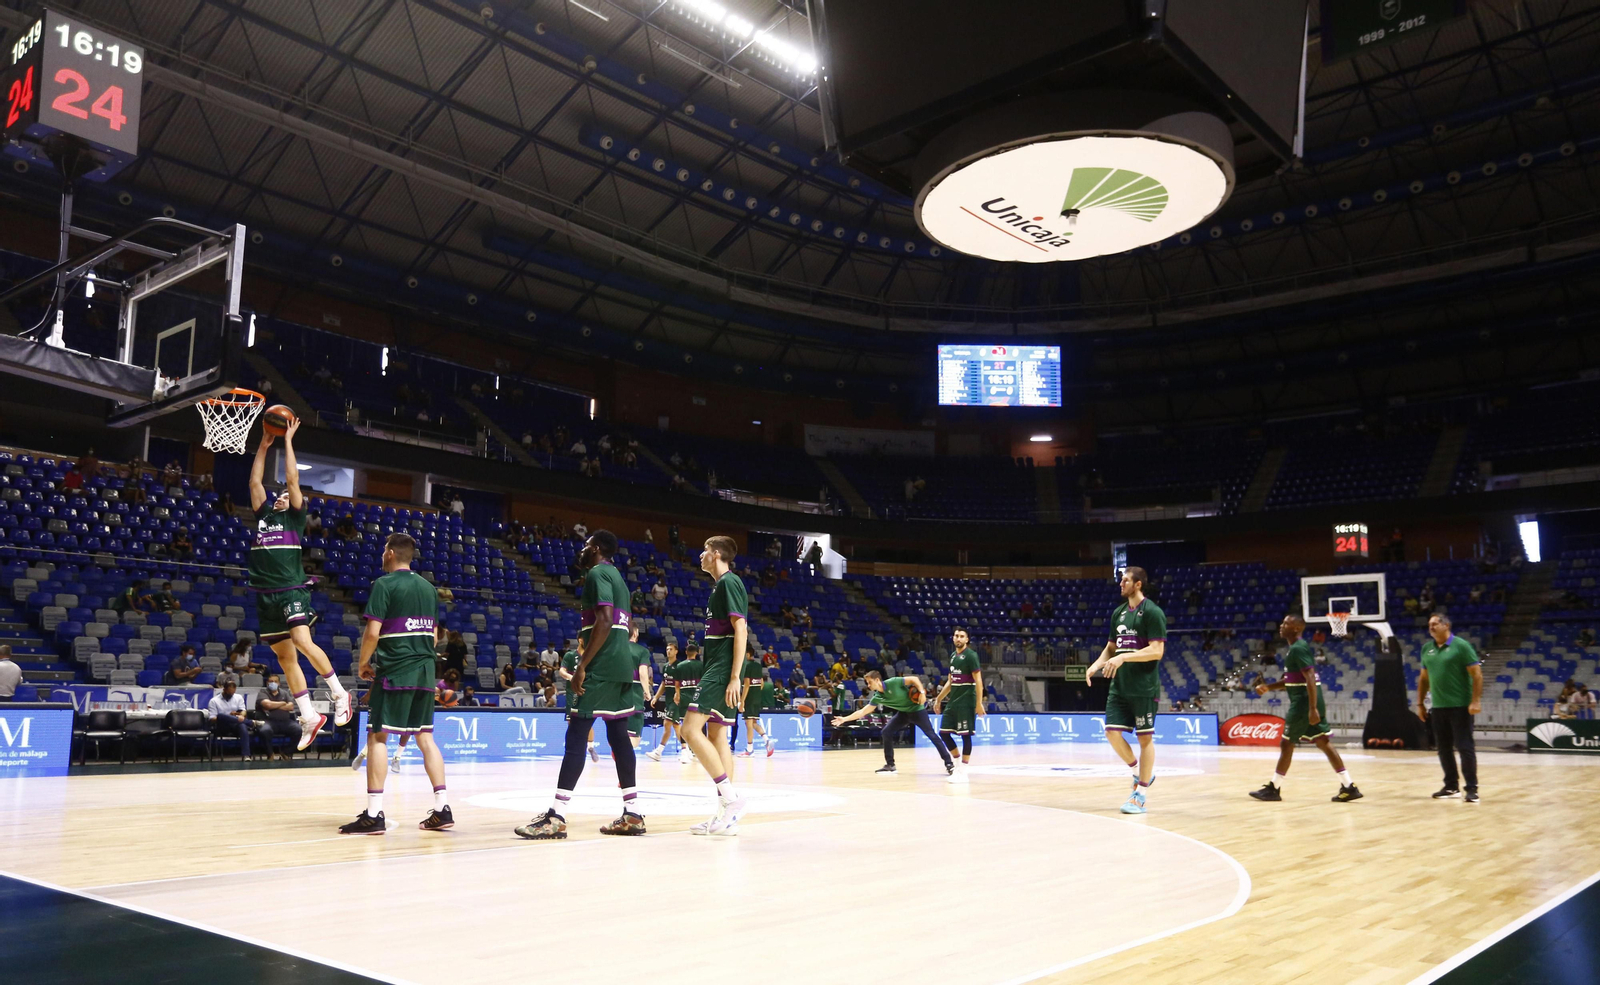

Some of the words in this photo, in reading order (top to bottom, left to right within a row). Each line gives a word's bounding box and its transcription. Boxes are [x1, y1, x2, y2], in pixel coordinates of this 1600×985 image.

[11, 18, 42, 66] 16:19
[55, 23, 143, 75] 16:19
[1358, 28, 1385, 46] 1999
[1398, 14, 1426, 33] 2012
[6, 65, 34, 129] 24
[51, 68, 128, 132] 24
[980, 196, 1072, 249] Unicaja
[1335, 535, 1358, 552] 24
[20, 749, 48, 759] málaga
[1228, 722, 1283, 740] Coca-Cola
